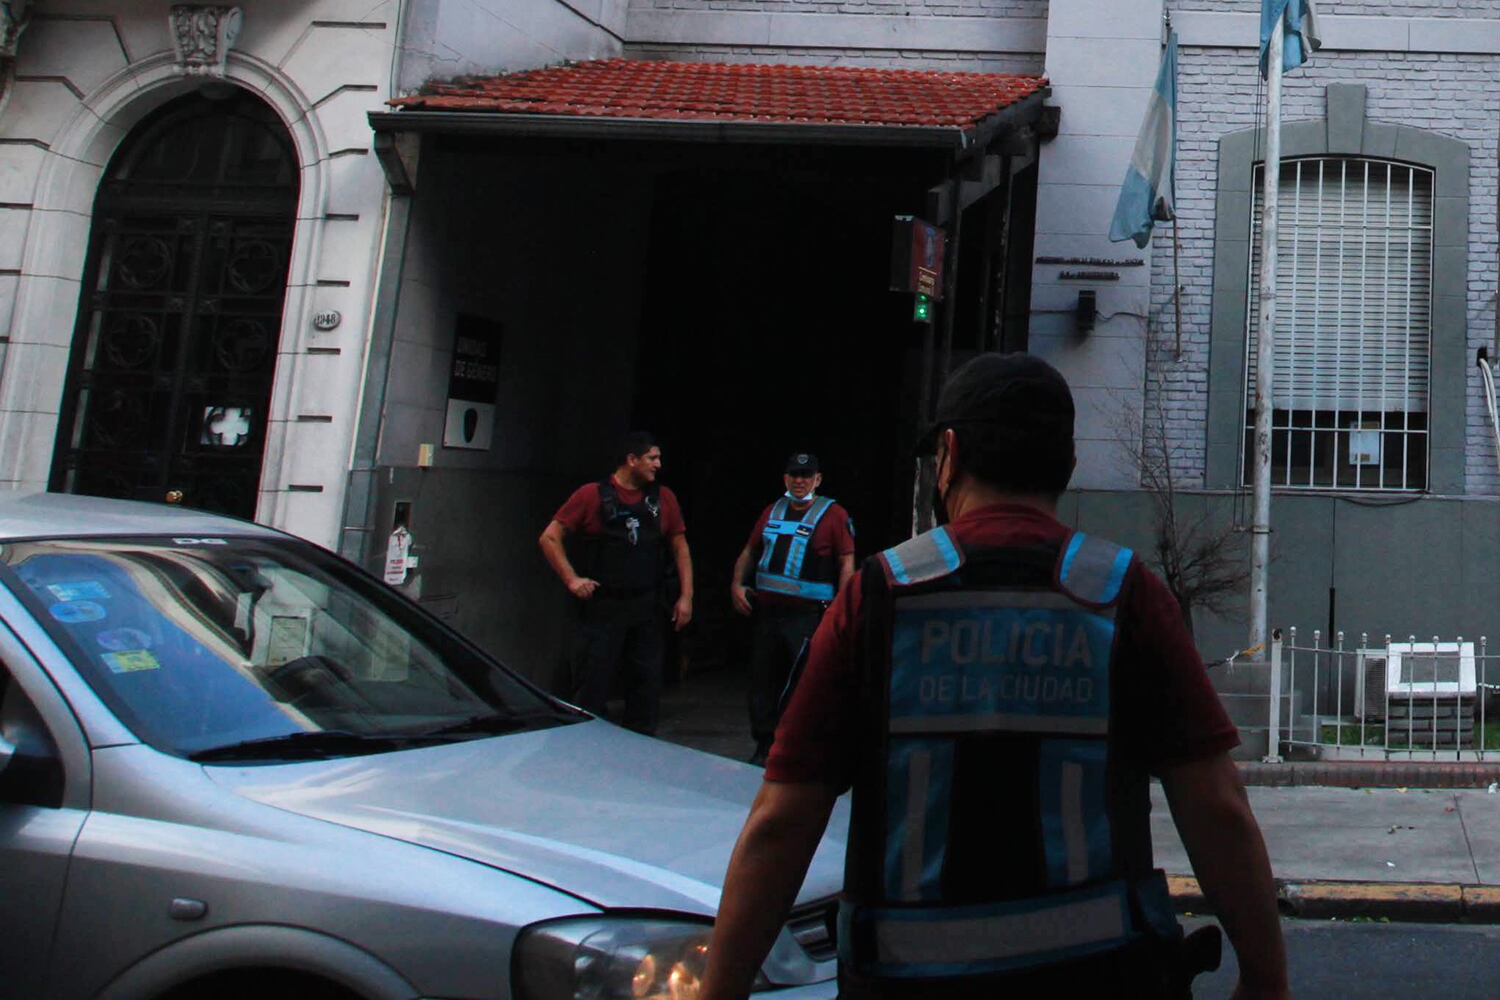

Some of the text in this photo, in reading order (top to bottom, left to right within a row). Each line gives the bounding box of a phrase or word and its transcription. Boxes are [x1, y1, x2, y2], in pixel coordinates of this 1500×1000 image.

[921, 619, 1093, 668] POLICIA
[919, 673, 1094, 703] DE LA CIUDAD
